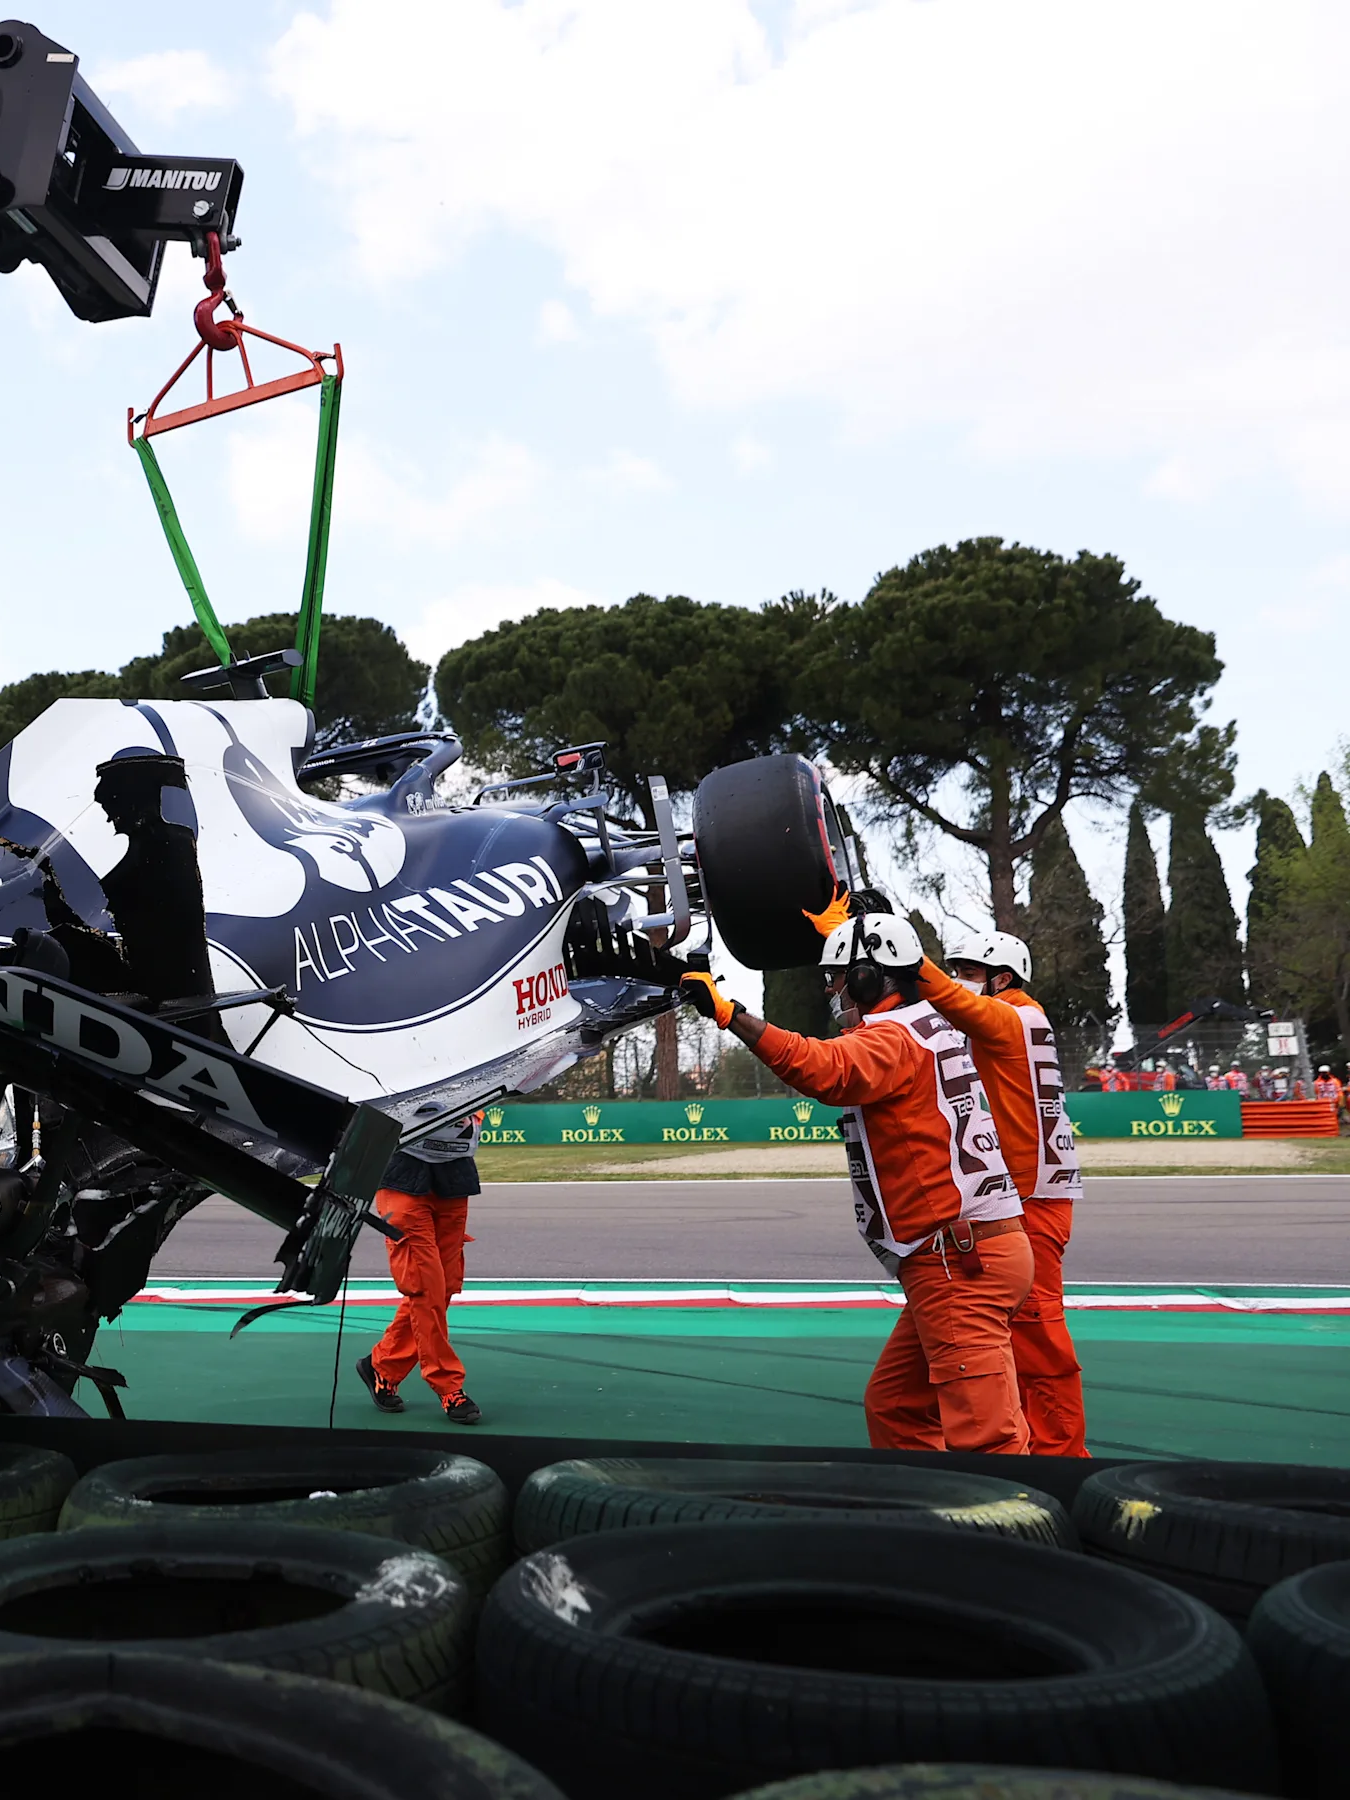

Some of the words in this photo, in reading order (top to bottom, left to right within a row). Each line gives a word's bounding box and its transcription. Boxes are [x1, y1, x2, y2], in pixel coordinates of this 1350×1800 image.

[129, 168, 223, 191] MANITOU
[294, 855, 564, 992] ALPHATAURI
[518, 1008, 552, 1030] HYBRID
[561, 1128, 625, 1143] ROLEX
[662, 1127, 729, 1142] ROLEX
[768, 1126, 840, 1141] ROLEX
[1131, 1120, 1217, 1136] ROLEX
[479, 1129, 526, 1143] OLEX
